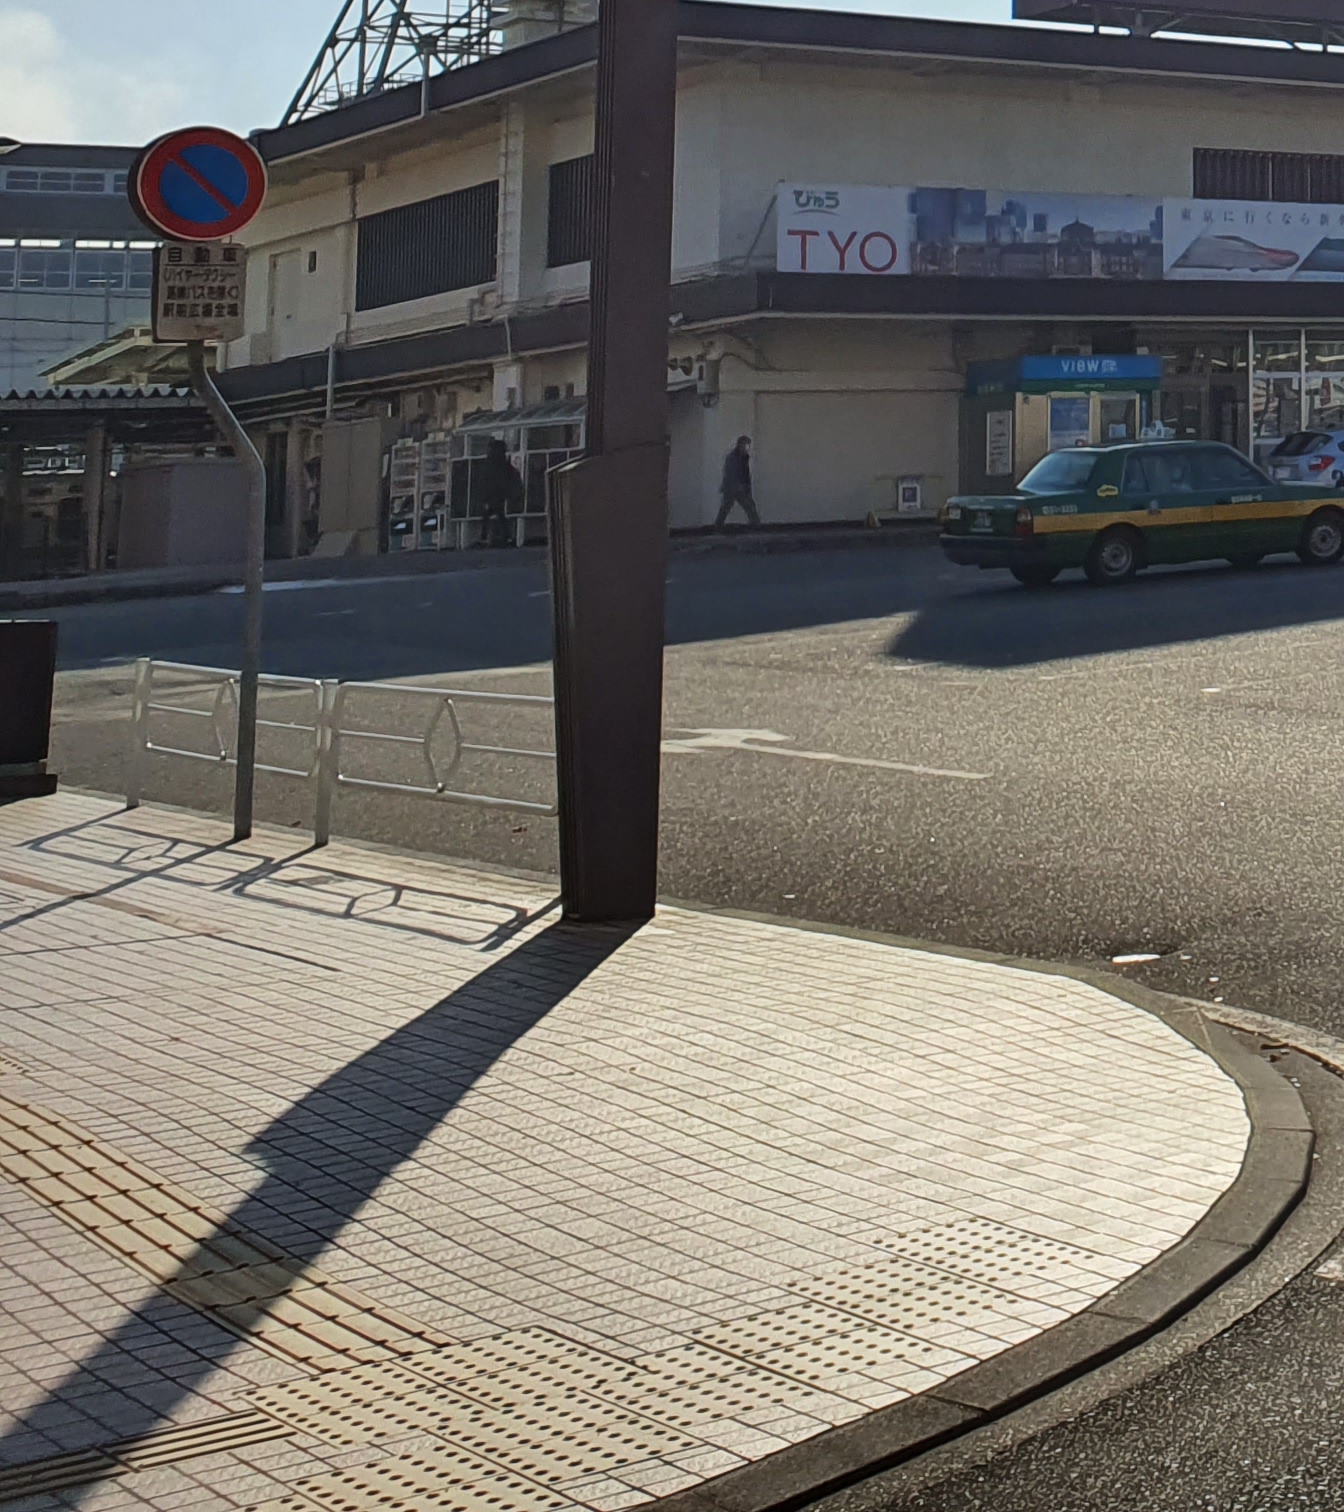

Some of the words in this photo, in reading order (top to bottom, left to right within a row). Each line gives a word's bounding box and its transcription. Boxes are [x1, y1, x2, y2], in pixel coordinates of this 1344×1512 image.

[793, 189, 840, 208] びゅう
[787, 229, 898, 273] TYO
